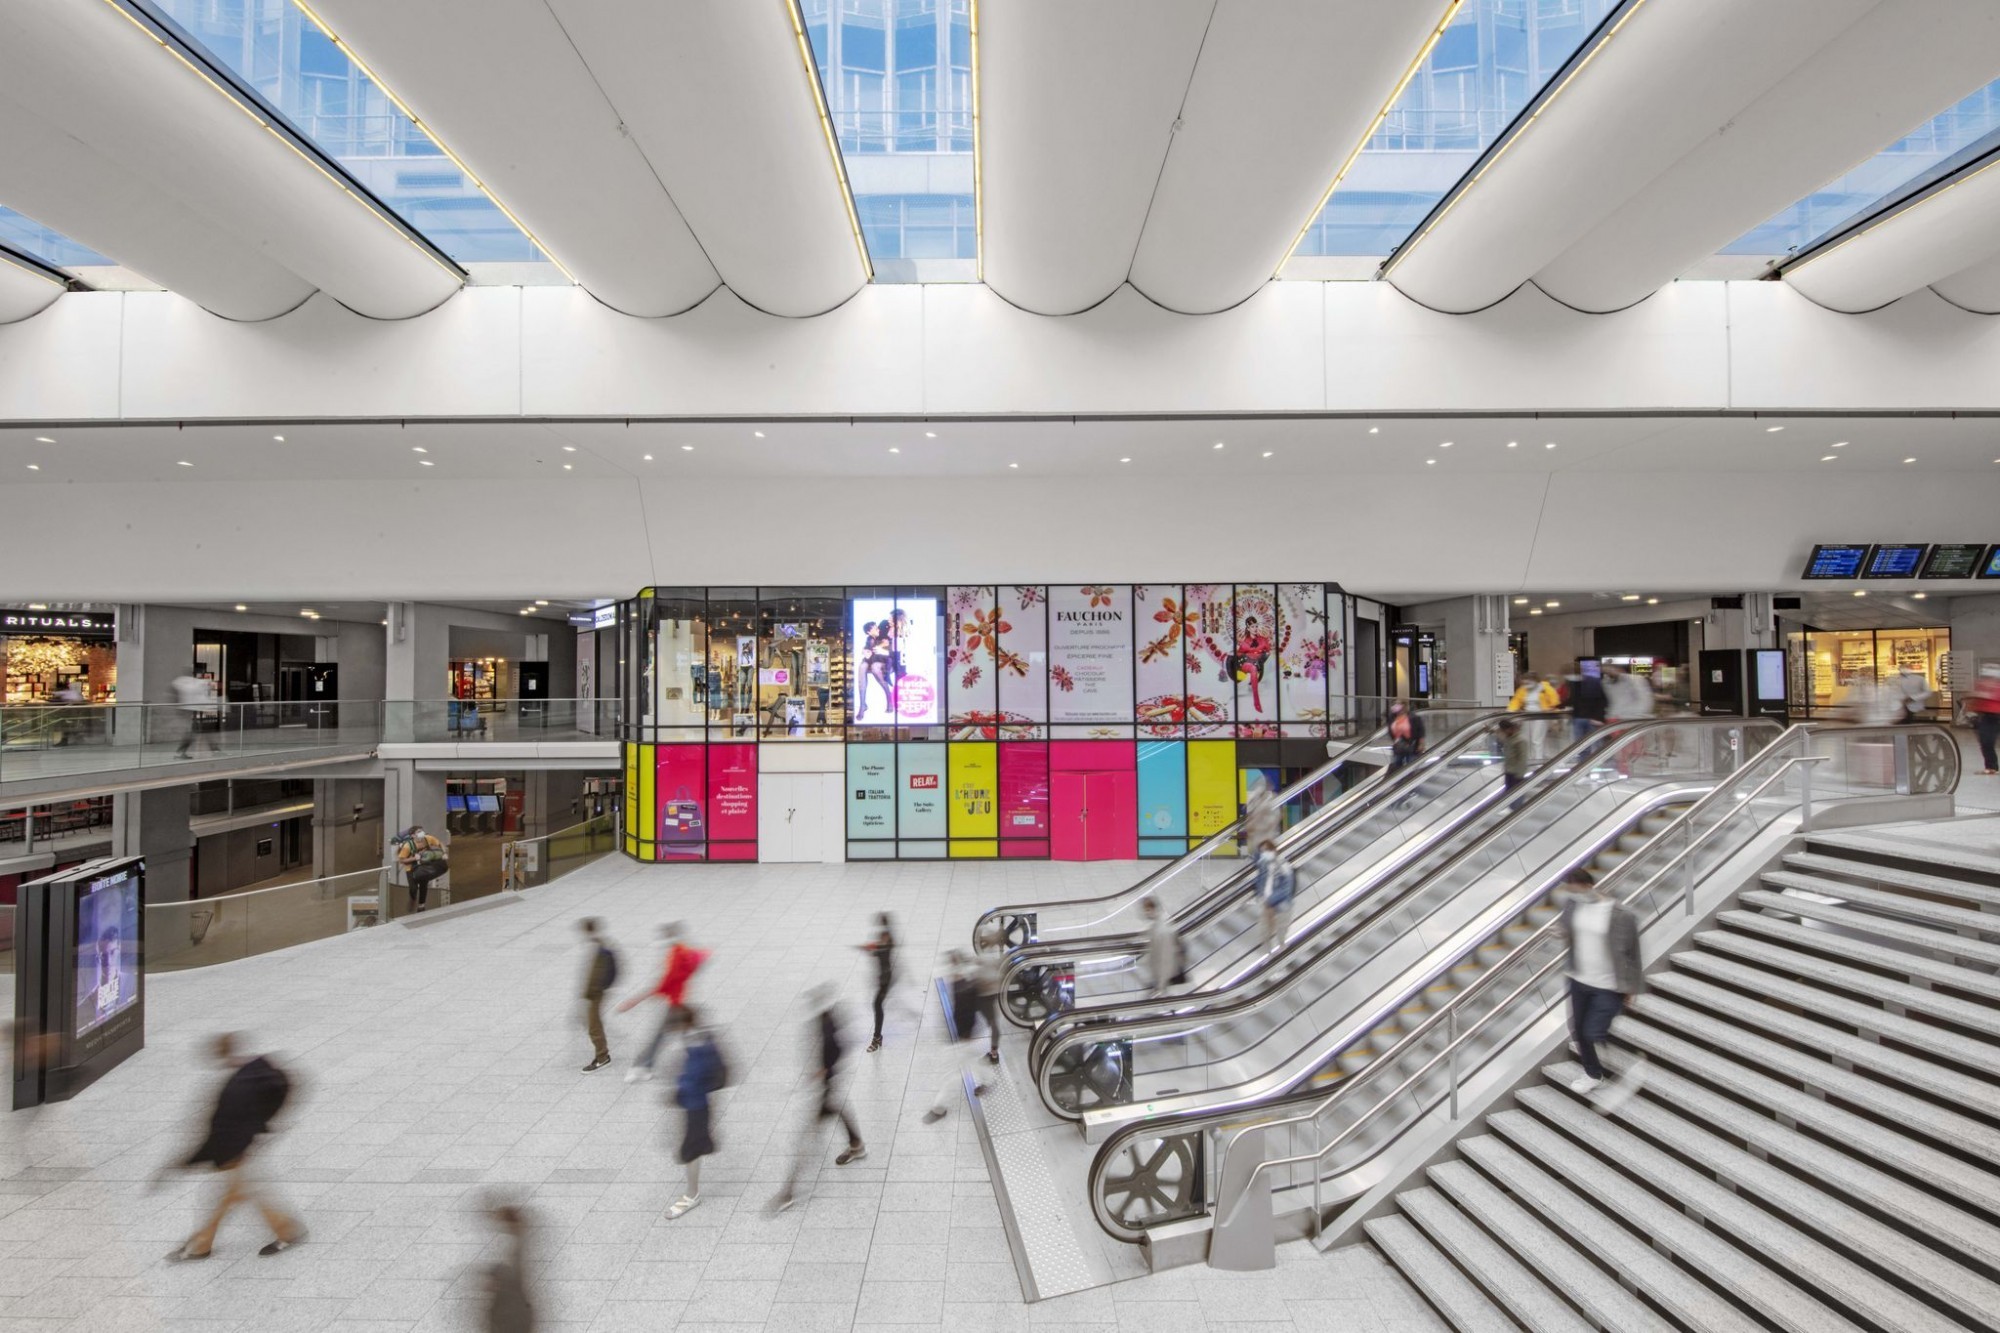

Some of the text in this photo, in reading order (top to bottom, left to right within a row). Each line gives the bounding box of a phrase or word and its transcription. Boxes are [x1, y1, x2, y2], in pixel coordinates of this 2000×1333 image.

[1057, 611, 1122, 622] FAUCHON
[912, 776, 935, 787] RELAY
[728, 808, 748, 816] plaisir
[968, 801, 991, 815] JEU
[110, 871, 128, 886] NOIRE
